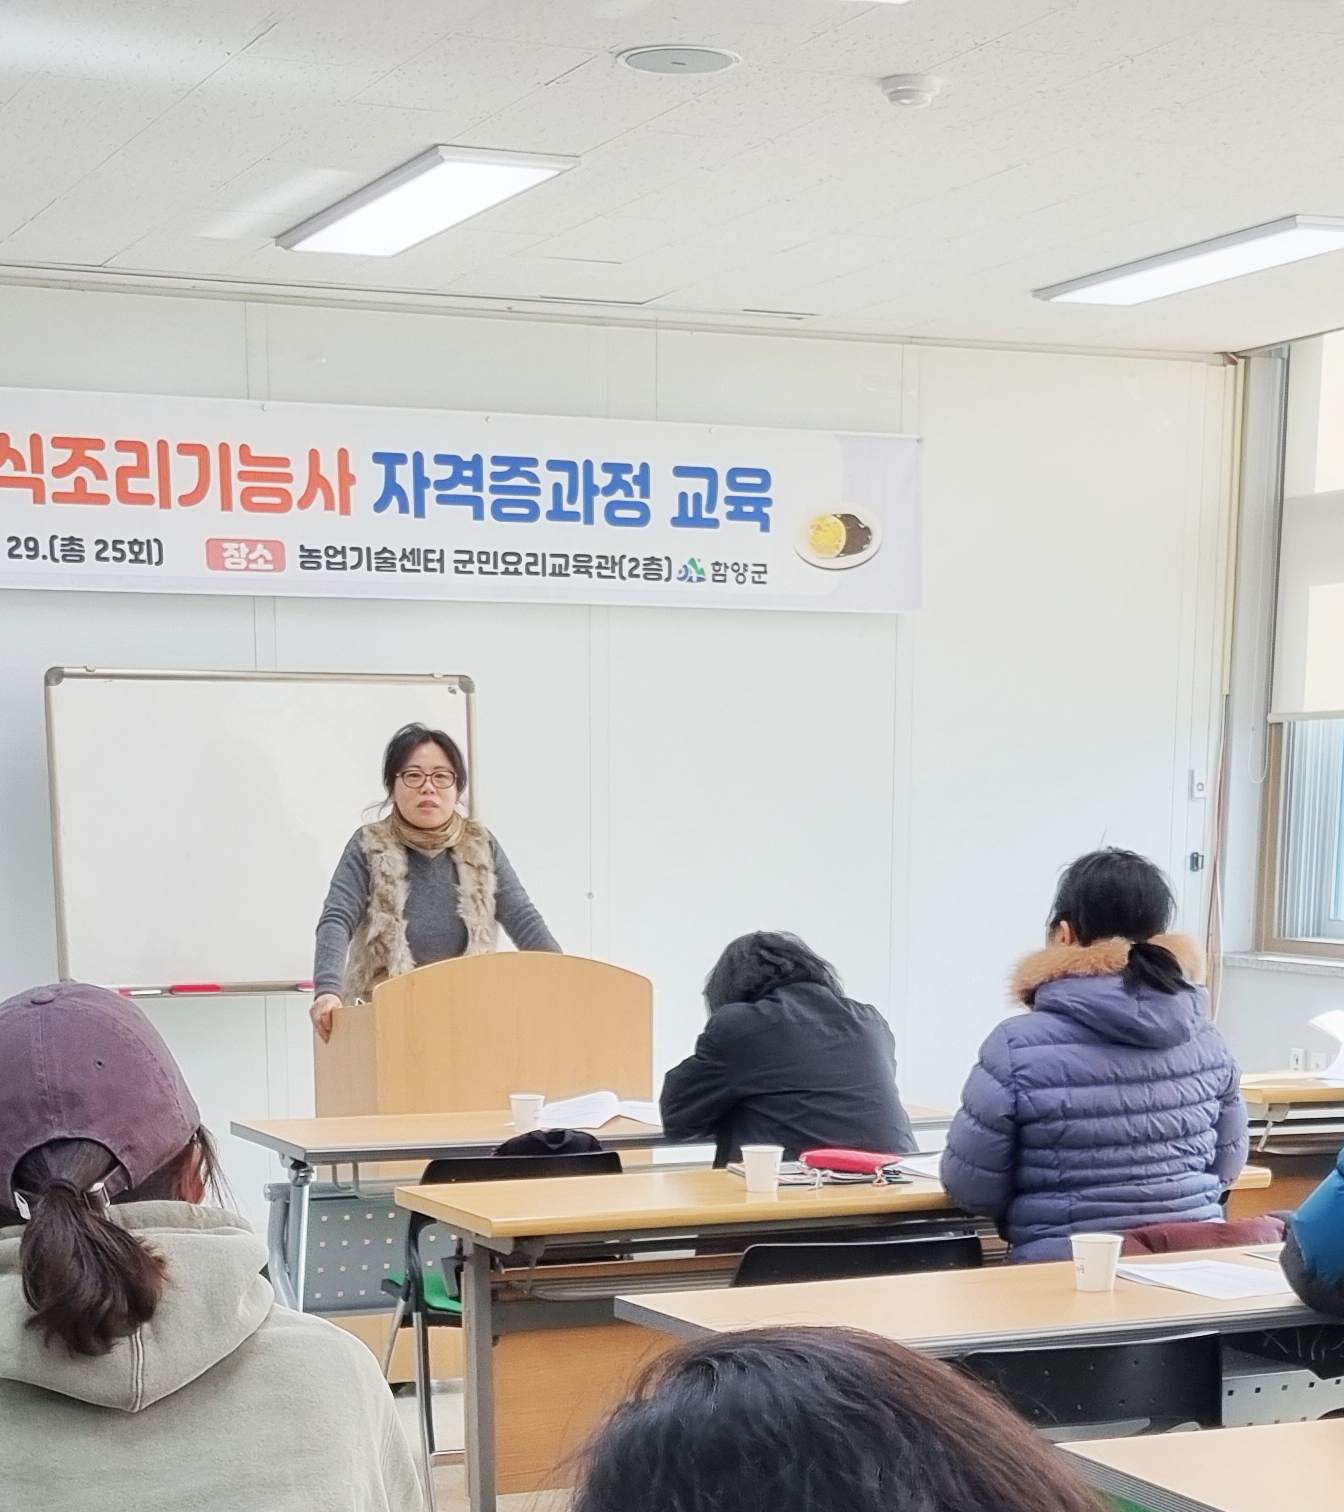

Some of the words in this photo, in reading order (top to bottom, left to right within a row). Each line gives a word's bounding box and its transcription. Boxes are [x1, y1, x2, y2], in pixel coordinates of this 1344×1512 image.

[372, 450, 652, 528] 자격증과정
[670, 464, 773, 532] 교육
[6, 535, 86, 564] 29.(총
[94, 538, 164, 567] 25회)
[221, 542, 275, 571] 장소
[298, 544, 445, 575] 농업기술센터
[452, 548, 673, 582] 군민요리교육관(2층)
[711, 560, 769, 585] 함양군
